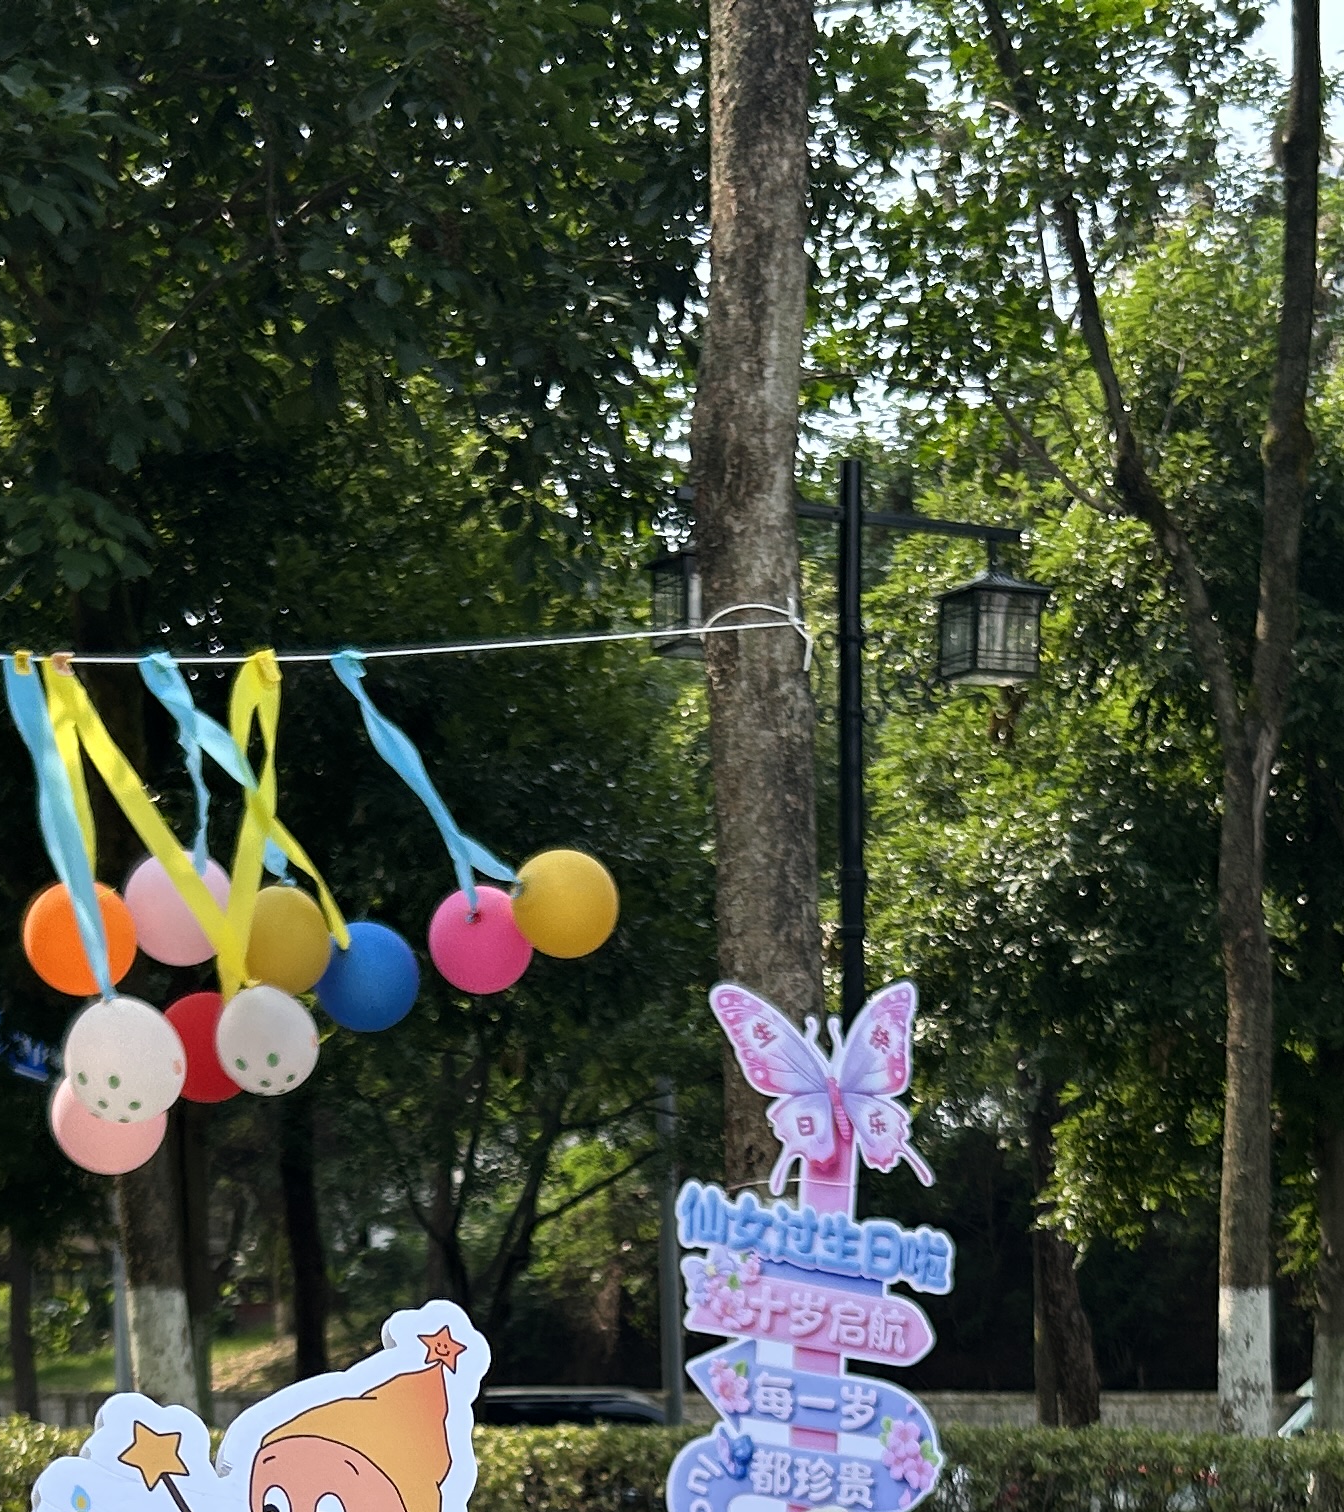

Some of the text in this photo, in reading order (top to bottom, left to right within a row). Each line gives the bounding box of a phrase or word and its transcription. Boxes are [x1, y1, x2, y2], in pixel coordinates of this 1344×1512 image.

[681, 1184, 949, 1289] 仙女过生日啦
[748, 1285, 907, 1354] 十岁启航
[755, 1371, 878, 1431] 每一岁
[751, 1450, 874, 1510] 都珍贵
